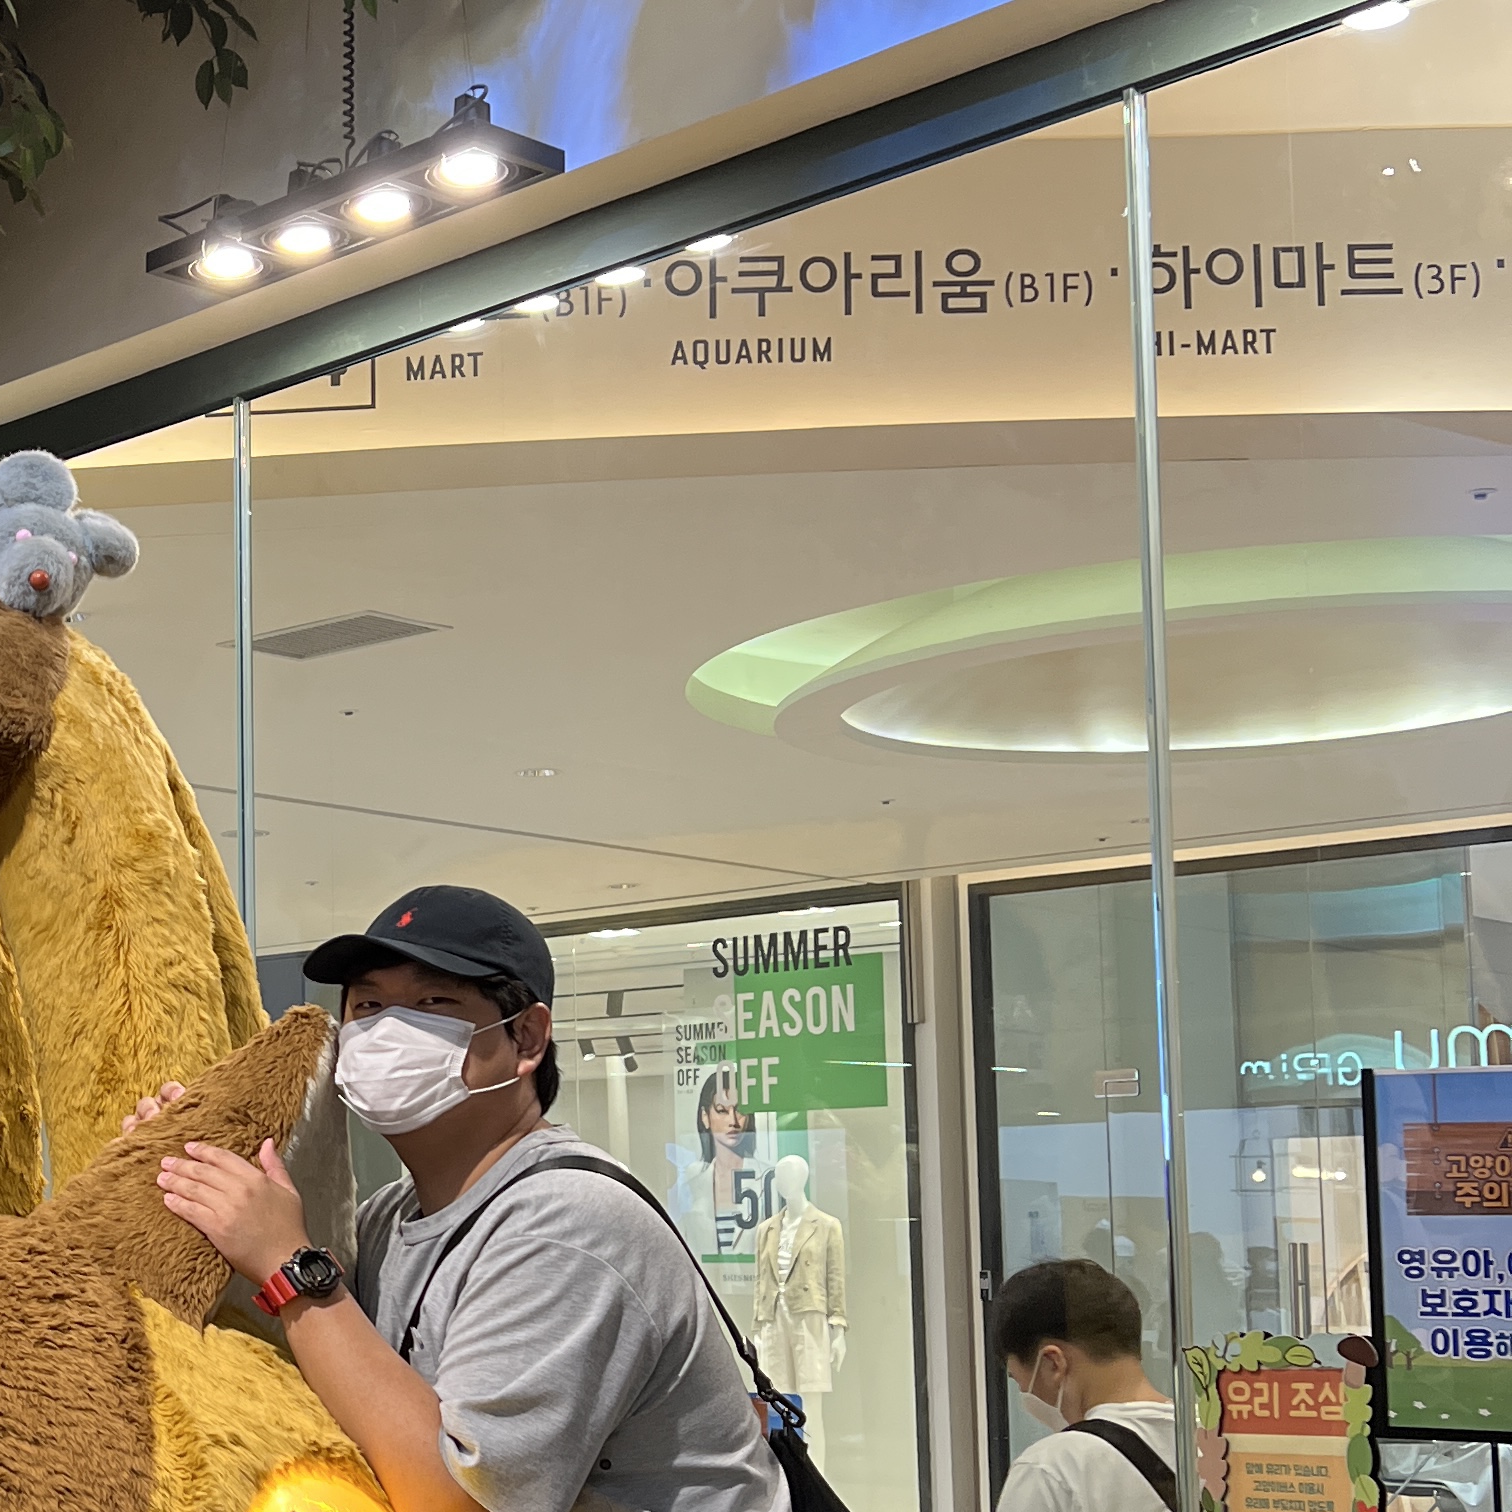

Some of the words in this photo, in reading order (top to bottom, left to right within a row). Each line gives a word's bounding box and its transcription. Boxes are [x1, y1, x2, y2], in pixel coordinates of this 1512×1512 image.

[663, 248, 995, 319] 아쿠아리움
[1004, 270, 1095, 307] (B1F)
[1152, 242, 1403, 309] 하이마트
[1414, 261, 1481, 299] (3F)
[406, 351, 484, 381] MART
[671, 337, 833, 369] AQUARIUM
[712, 925, 853, 978] SUMMER
[713, 983, 856, 1041] SEASON
[675, 1021, 728, 1042] SUMM
[676, 1043, 727, 1065] SEASON
[677, 1067, 700, 1086] OFF
[716, 1055, 780, 1107] OFF
[1454, 1181, 1509, 1207] 주의
[1397, 1249, 1512, 1284] 영유아,
[1419, 1288, 1512, 1318] 보호자
[1227, 1381, 1279, 1419] 유리
[1289, 1382, 1347, 1421] 조심
